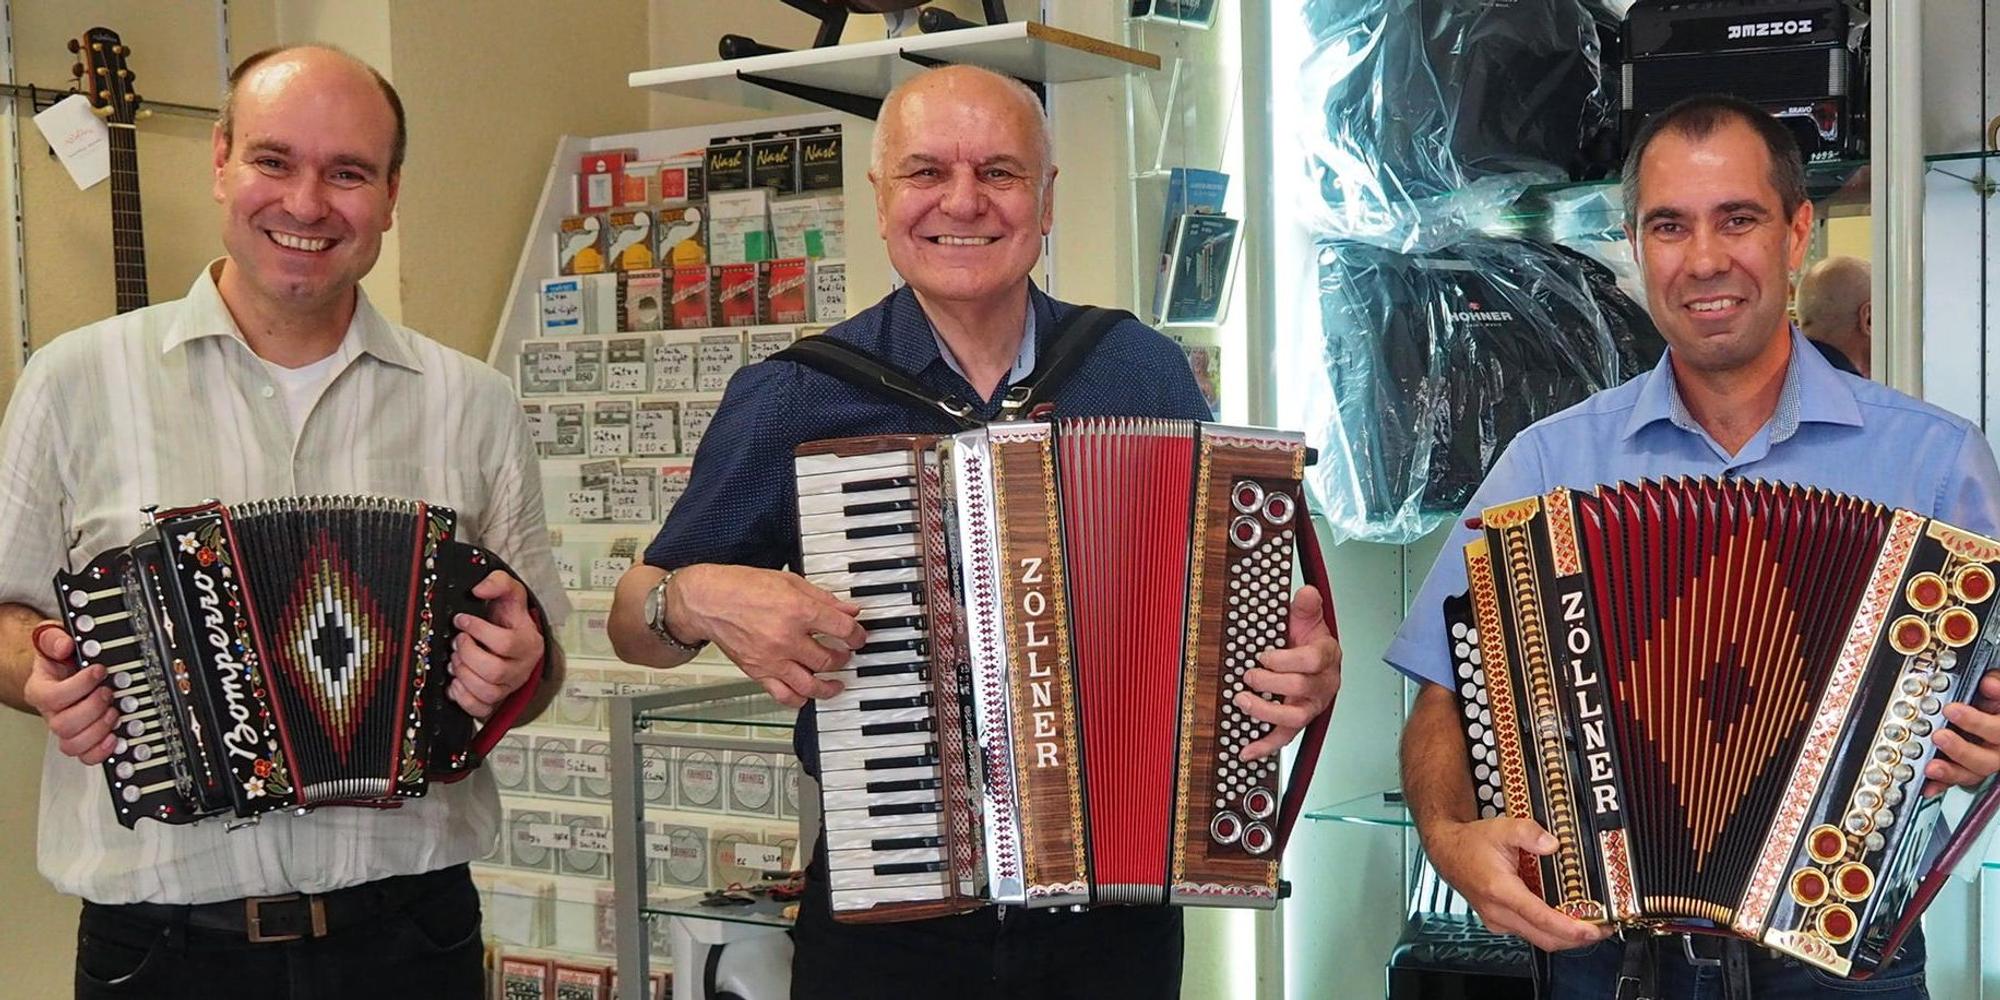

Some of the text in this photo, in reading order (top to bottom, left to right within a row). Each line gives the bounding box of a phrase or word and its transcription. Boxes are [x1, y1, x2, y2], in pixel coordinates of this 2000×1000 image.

[1727, 19, 1813, 40] HOHNER
[1788, 105, 1813, 114] BRAVO
[710, 149, 742, 171] Nash
[756, 145, 789, 167] Nash
[803, 140, 837, 162] Nash
[1450, 311, 1514, 322] HOHNER
[1020, 557, 1060, 769] ZÖLLNER
[1561, 591, 1619, 815] ZÖLLNER
